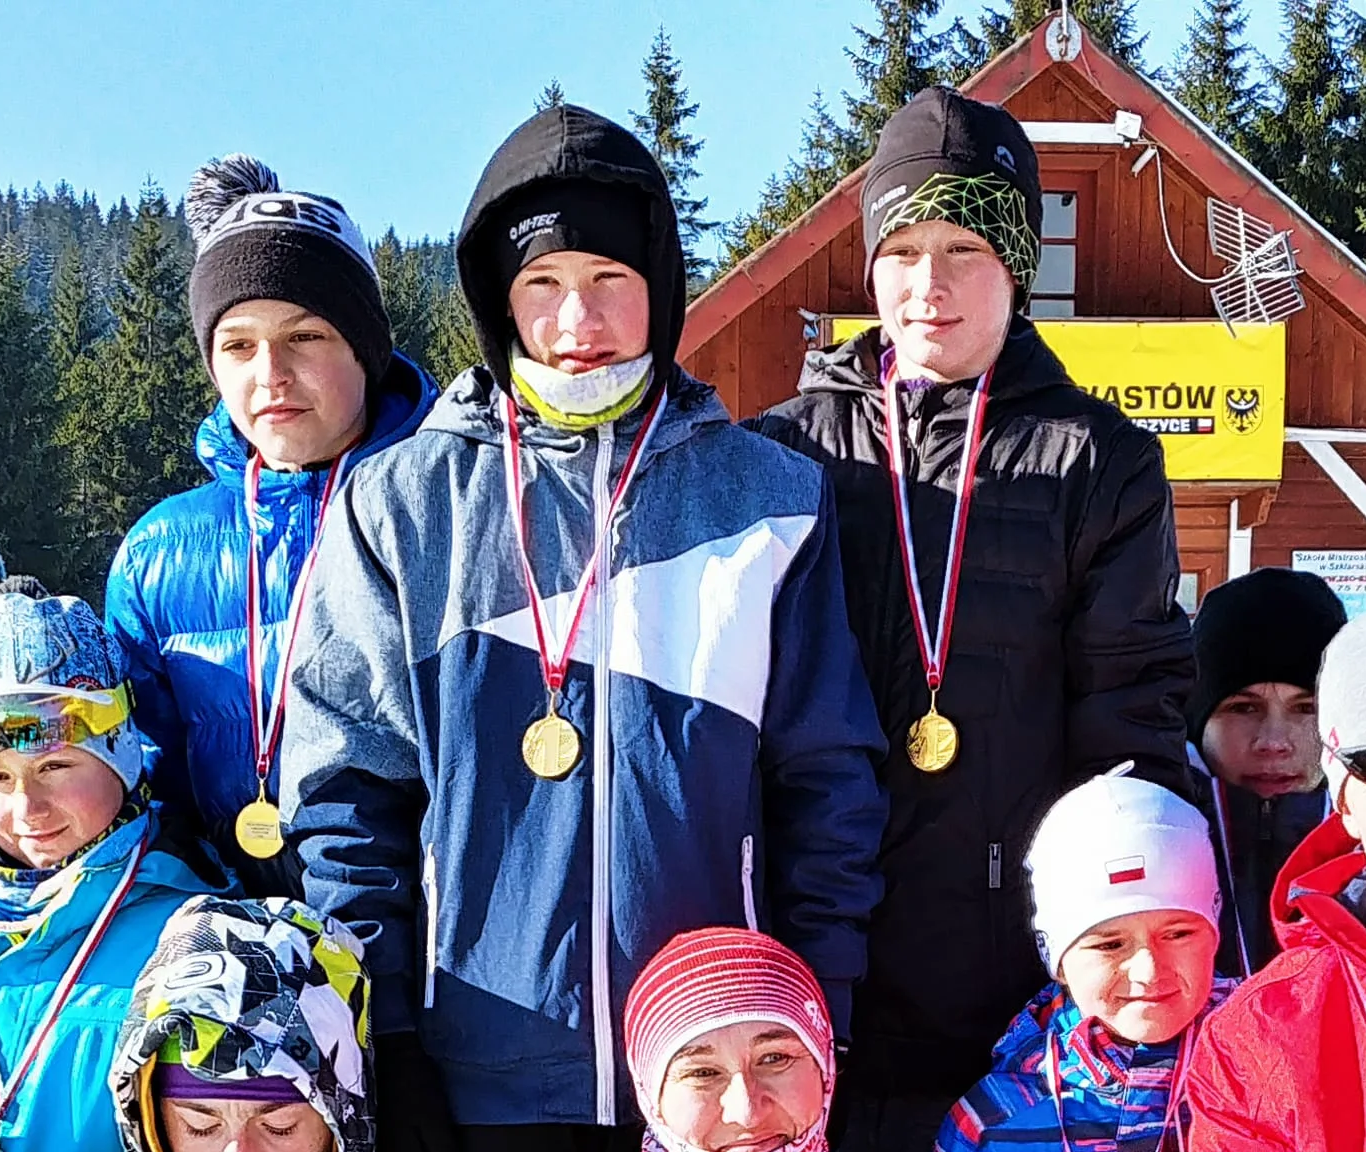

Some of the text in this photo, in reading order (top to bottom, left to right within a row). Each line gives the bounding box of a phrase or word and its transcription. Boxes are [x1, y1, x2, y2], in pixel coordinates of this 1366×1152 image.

[518, 211, 560, 236] HI-TEC
[1080, 382, 1216, 410] IASTÓW
[1132, 418, 1190, 432] SZYCE
